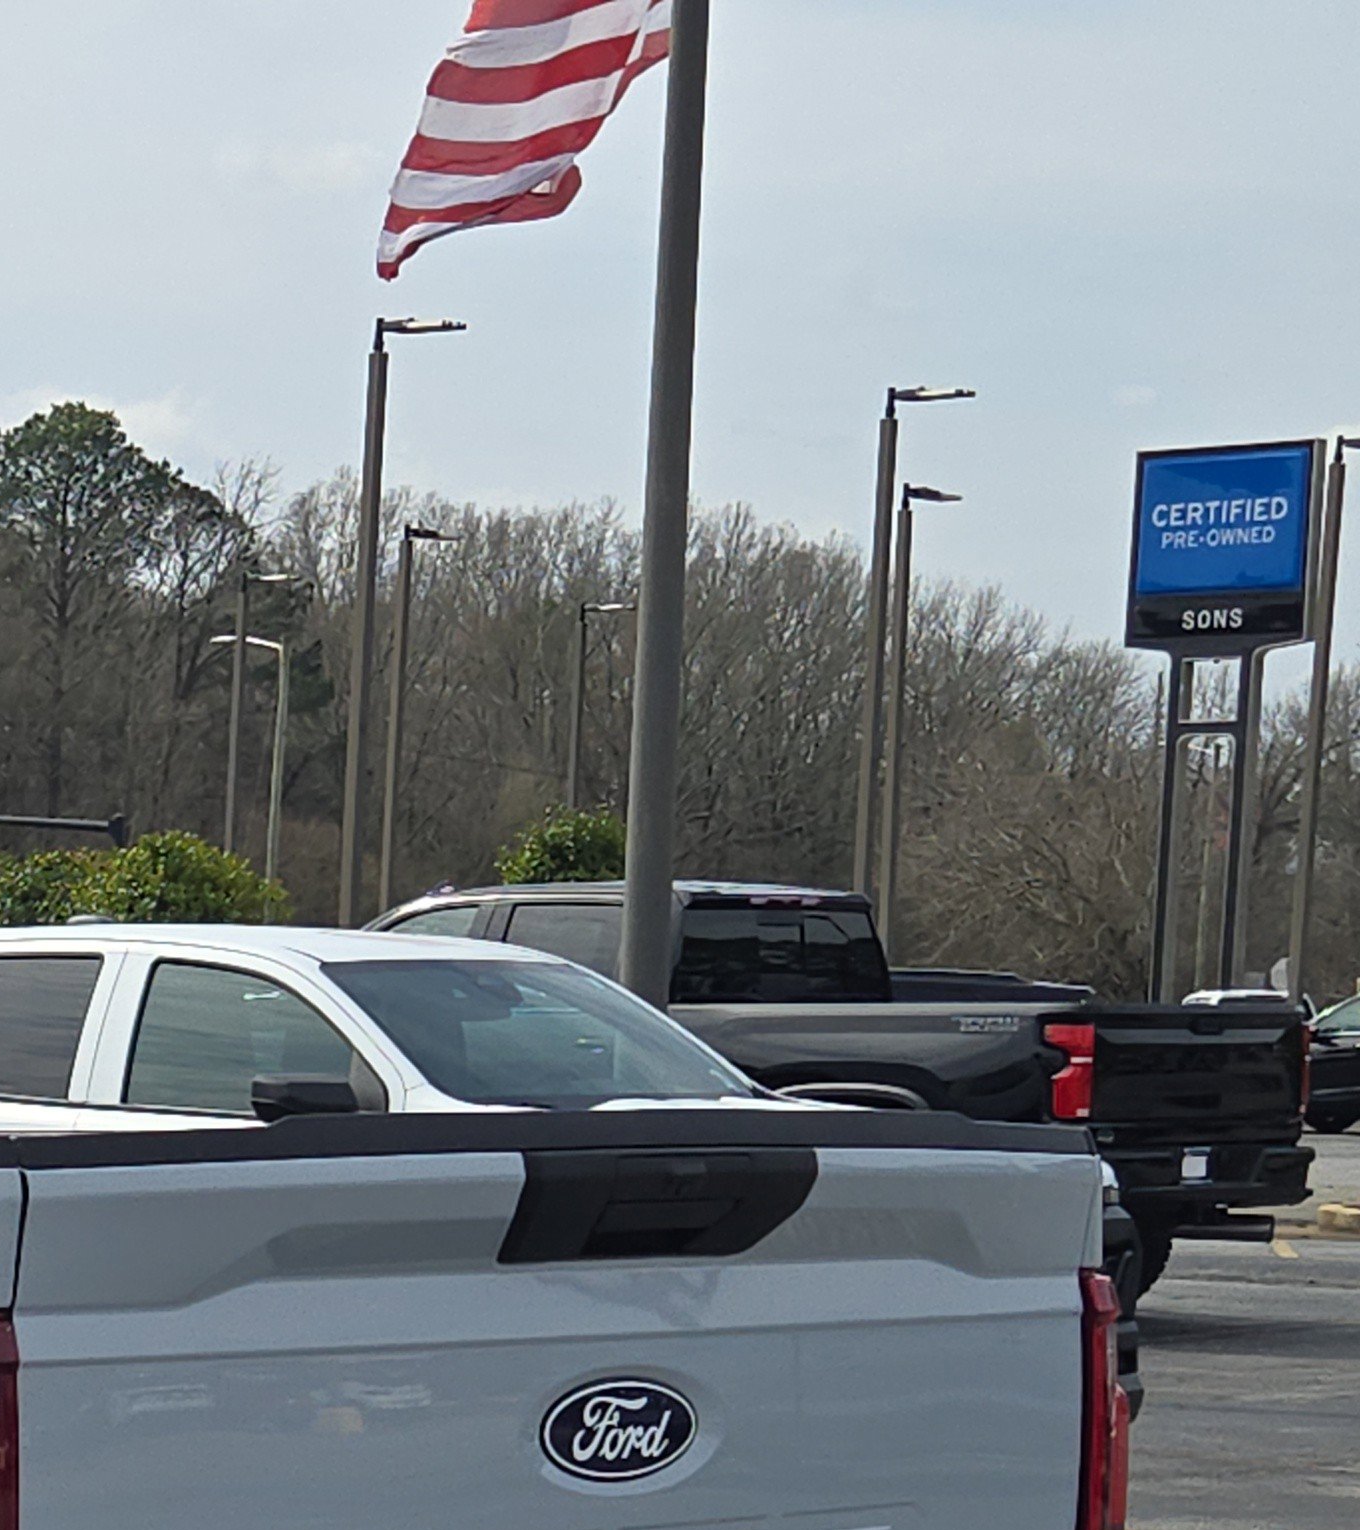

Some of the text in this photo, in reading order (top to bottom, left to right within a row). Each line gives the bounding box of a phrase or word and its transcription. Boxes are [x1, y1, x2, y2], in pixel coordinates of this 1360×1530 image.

[1152, 497, 1288, 527] CERTIFIED
[1160, 526, 1276, 549] PRE-OWNED
[1181, 607, 1244, 631] SONS
[573, 1395, 672, 1461] Ford
